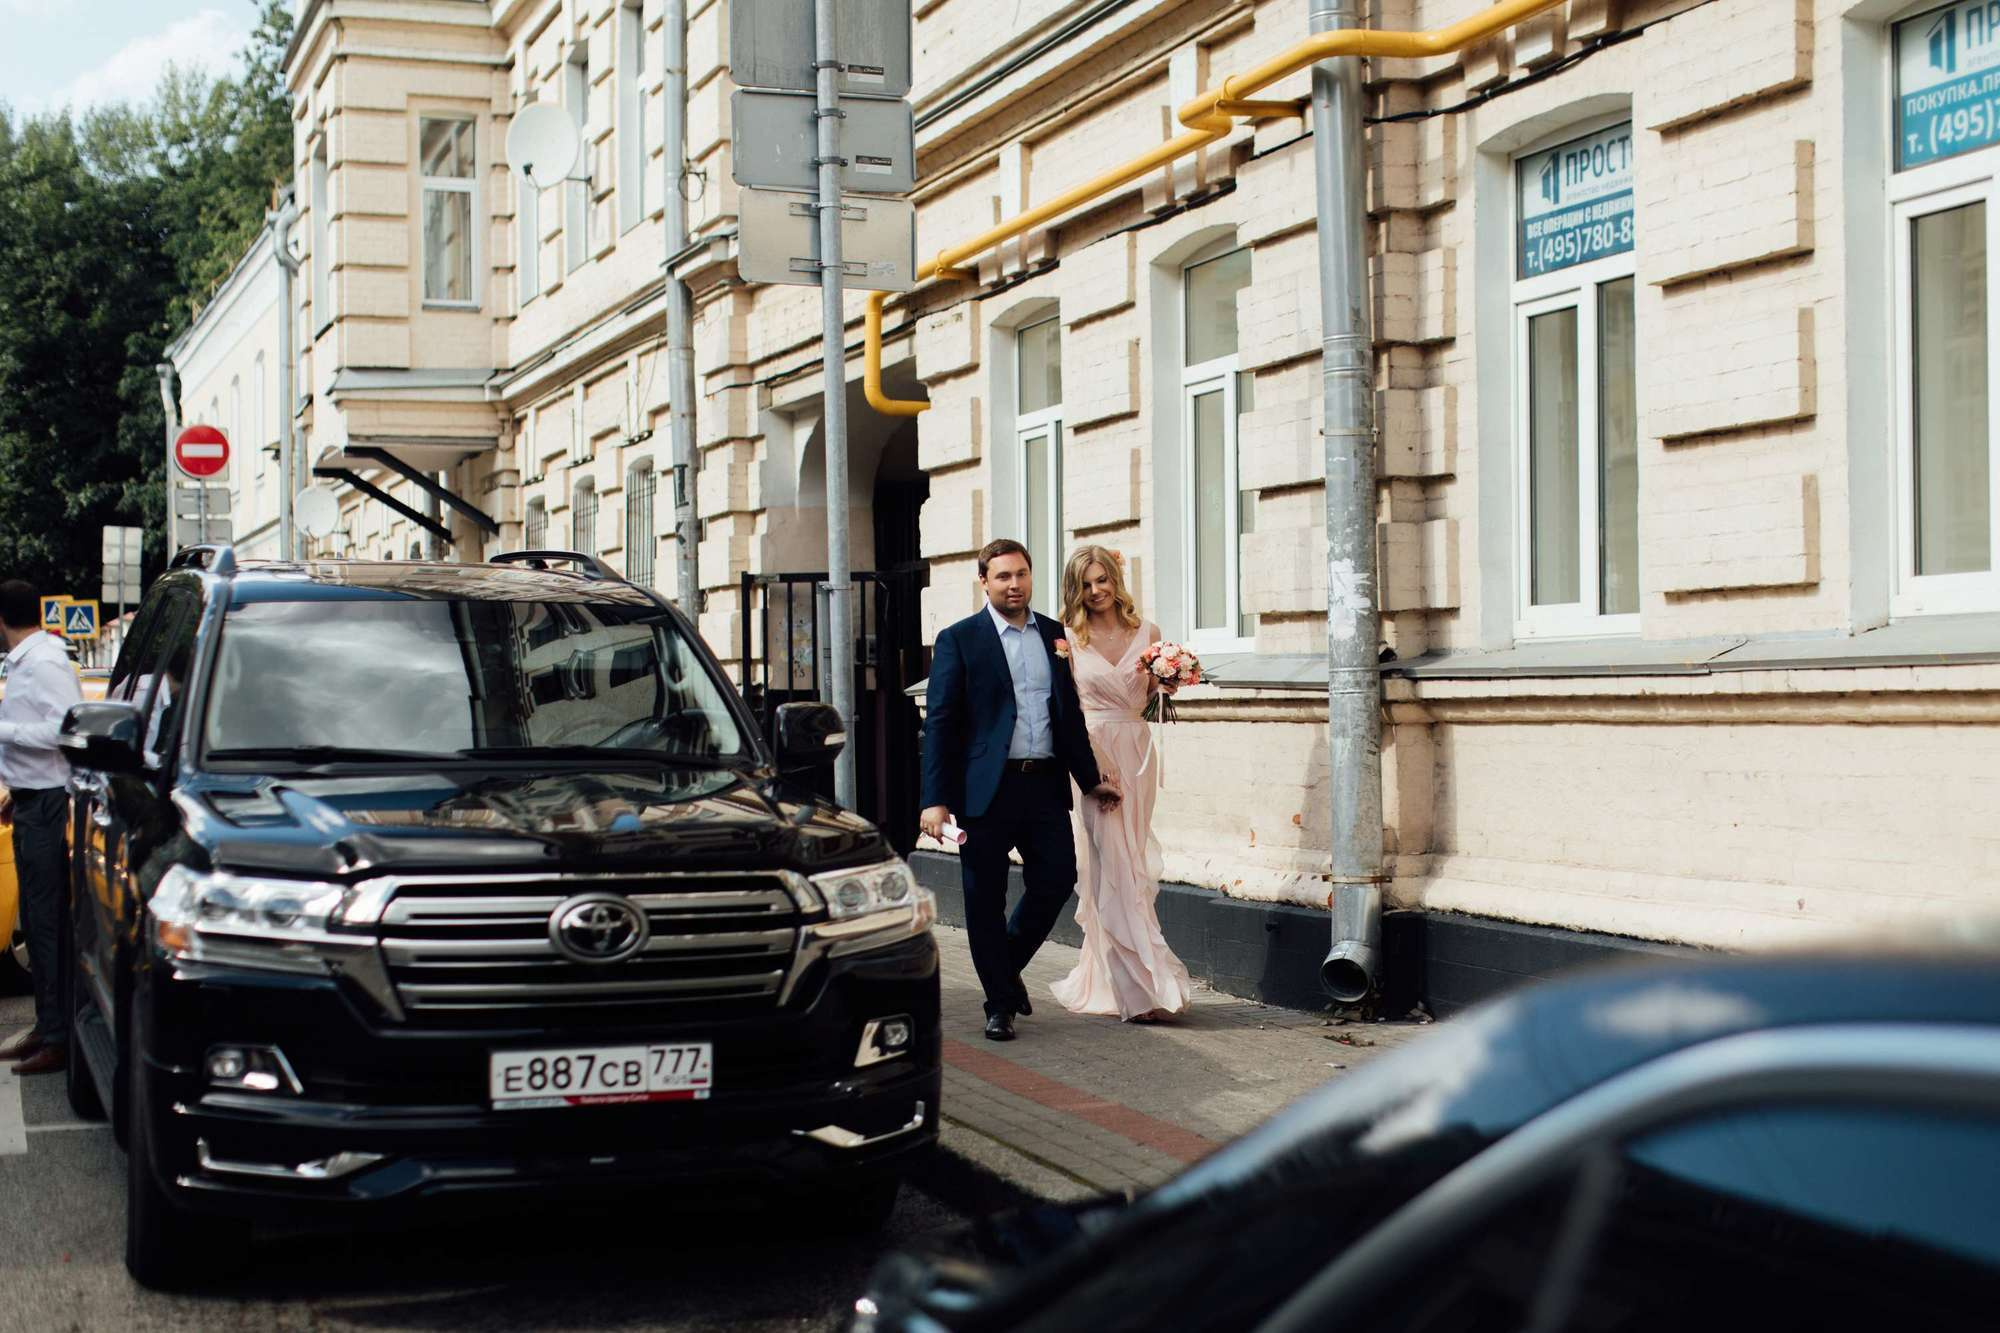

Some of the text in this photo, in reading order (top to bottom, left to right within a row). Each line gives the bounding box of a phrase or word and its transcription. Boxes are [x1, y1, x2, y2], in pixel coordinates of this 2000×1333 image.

[1967, 0, 2000, 48] ПР
[1566, 135, 1633, 186] ПРОСТ
[1527, 216, 1635, 272] т.(495)780-8
[650, 1047, 702, 1075] 777
